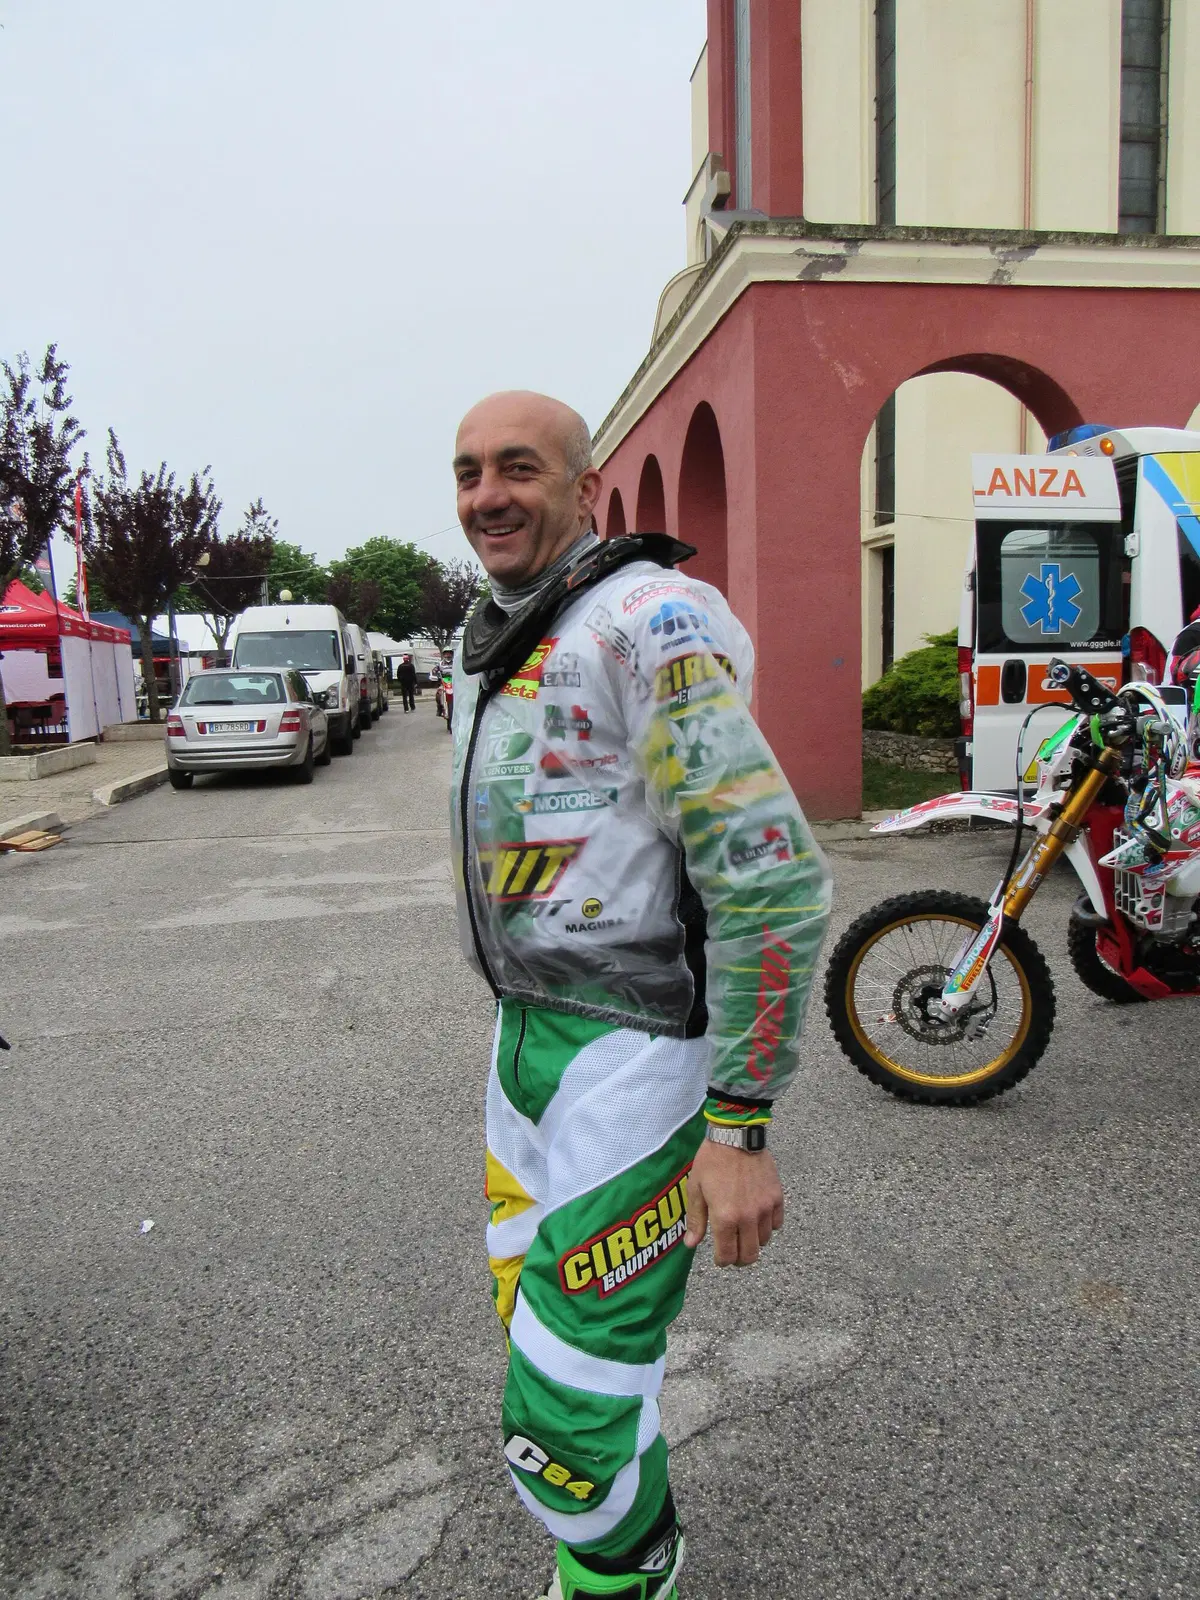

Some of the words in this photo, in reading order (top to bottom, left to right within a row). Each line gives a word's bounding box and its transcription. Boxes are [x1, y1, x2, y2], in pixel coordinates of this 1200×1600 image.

[974, 468, 1087, 498] ANZA
[501, 683, 538, 699] Beta
[534, 788, 616, 811] MOTOREX
[603, 1216, 688, 1293] EQUIPMEN
